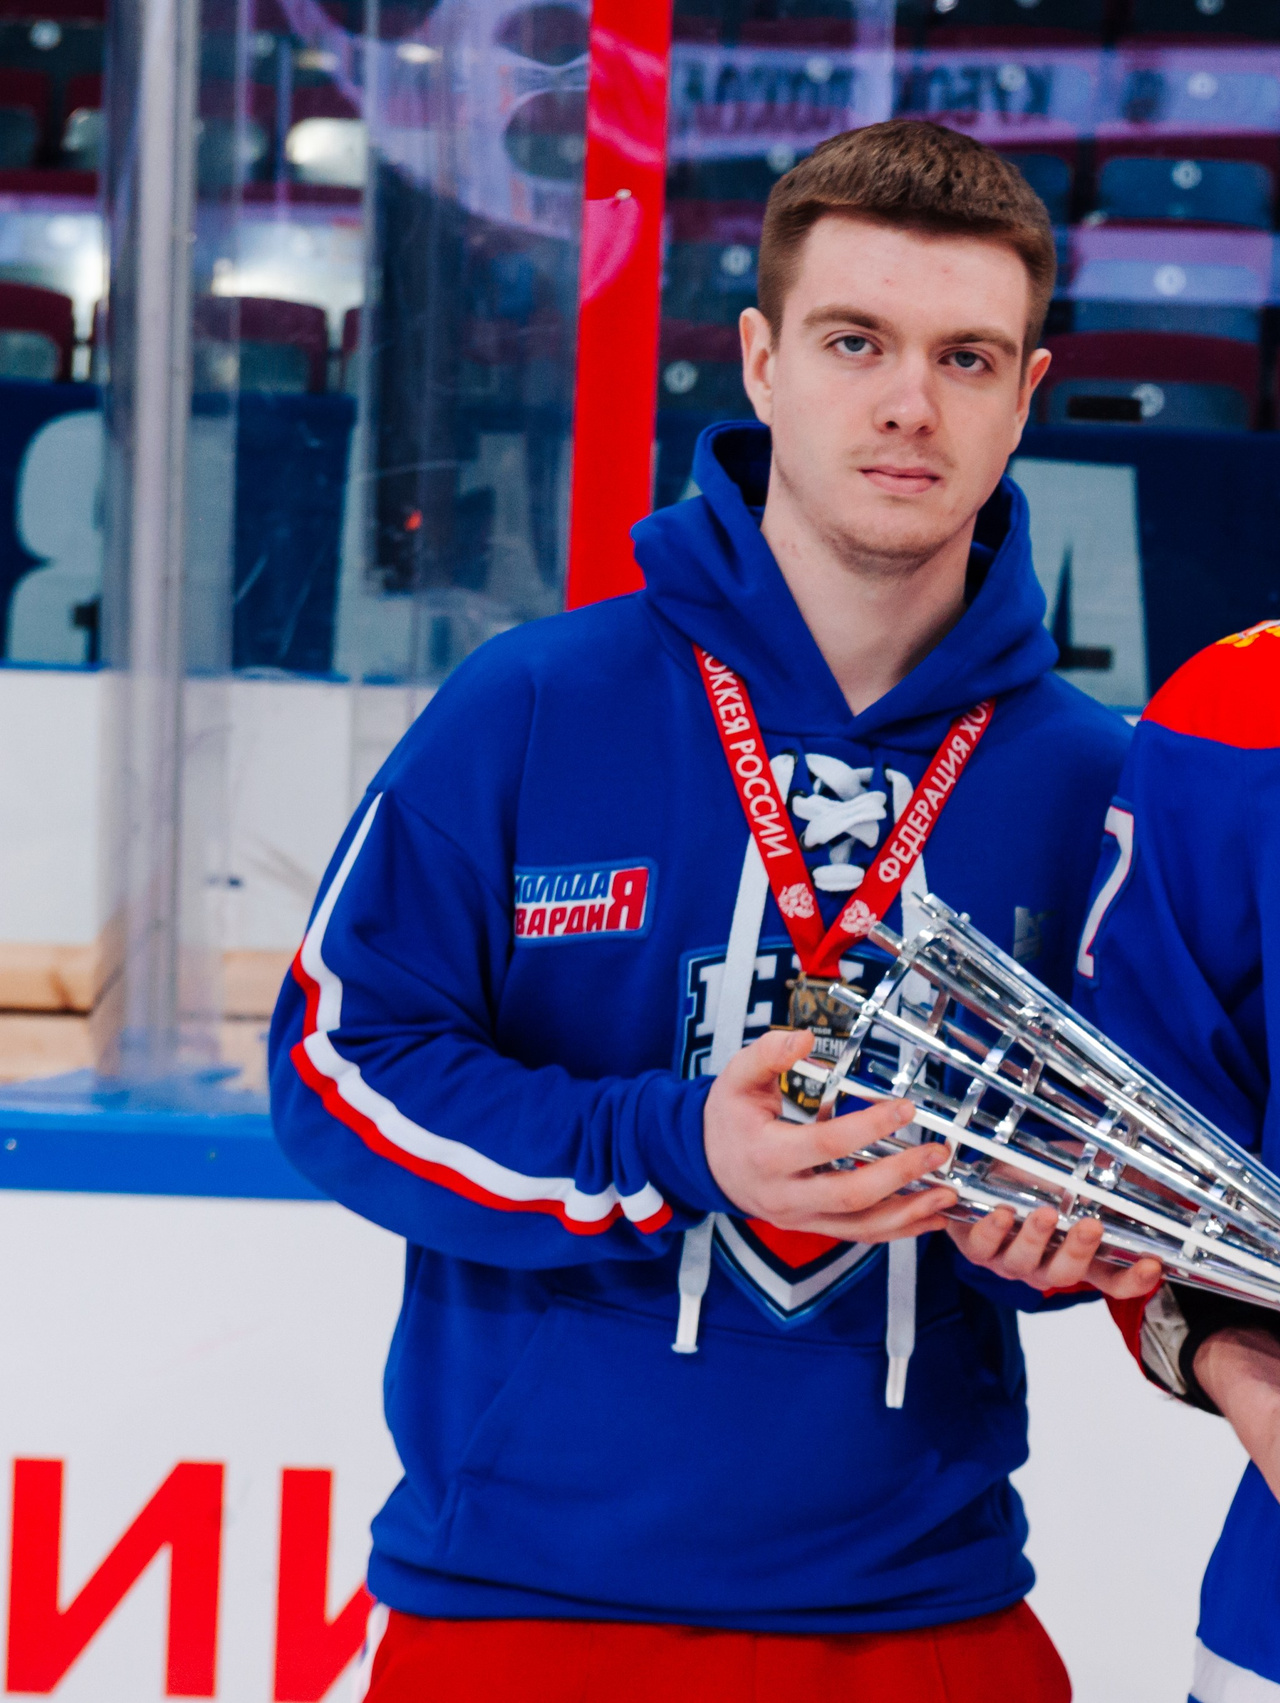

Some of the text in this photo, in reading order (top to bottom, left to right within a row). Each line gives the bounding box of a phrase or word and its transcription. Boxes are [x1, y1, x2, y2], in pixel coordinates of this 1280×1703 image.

[702, 651, 793, 860] ОККЕЯ РОССИИ
[878, 702, 989, 884] ФЕДЕРАЦИЯ ХО
